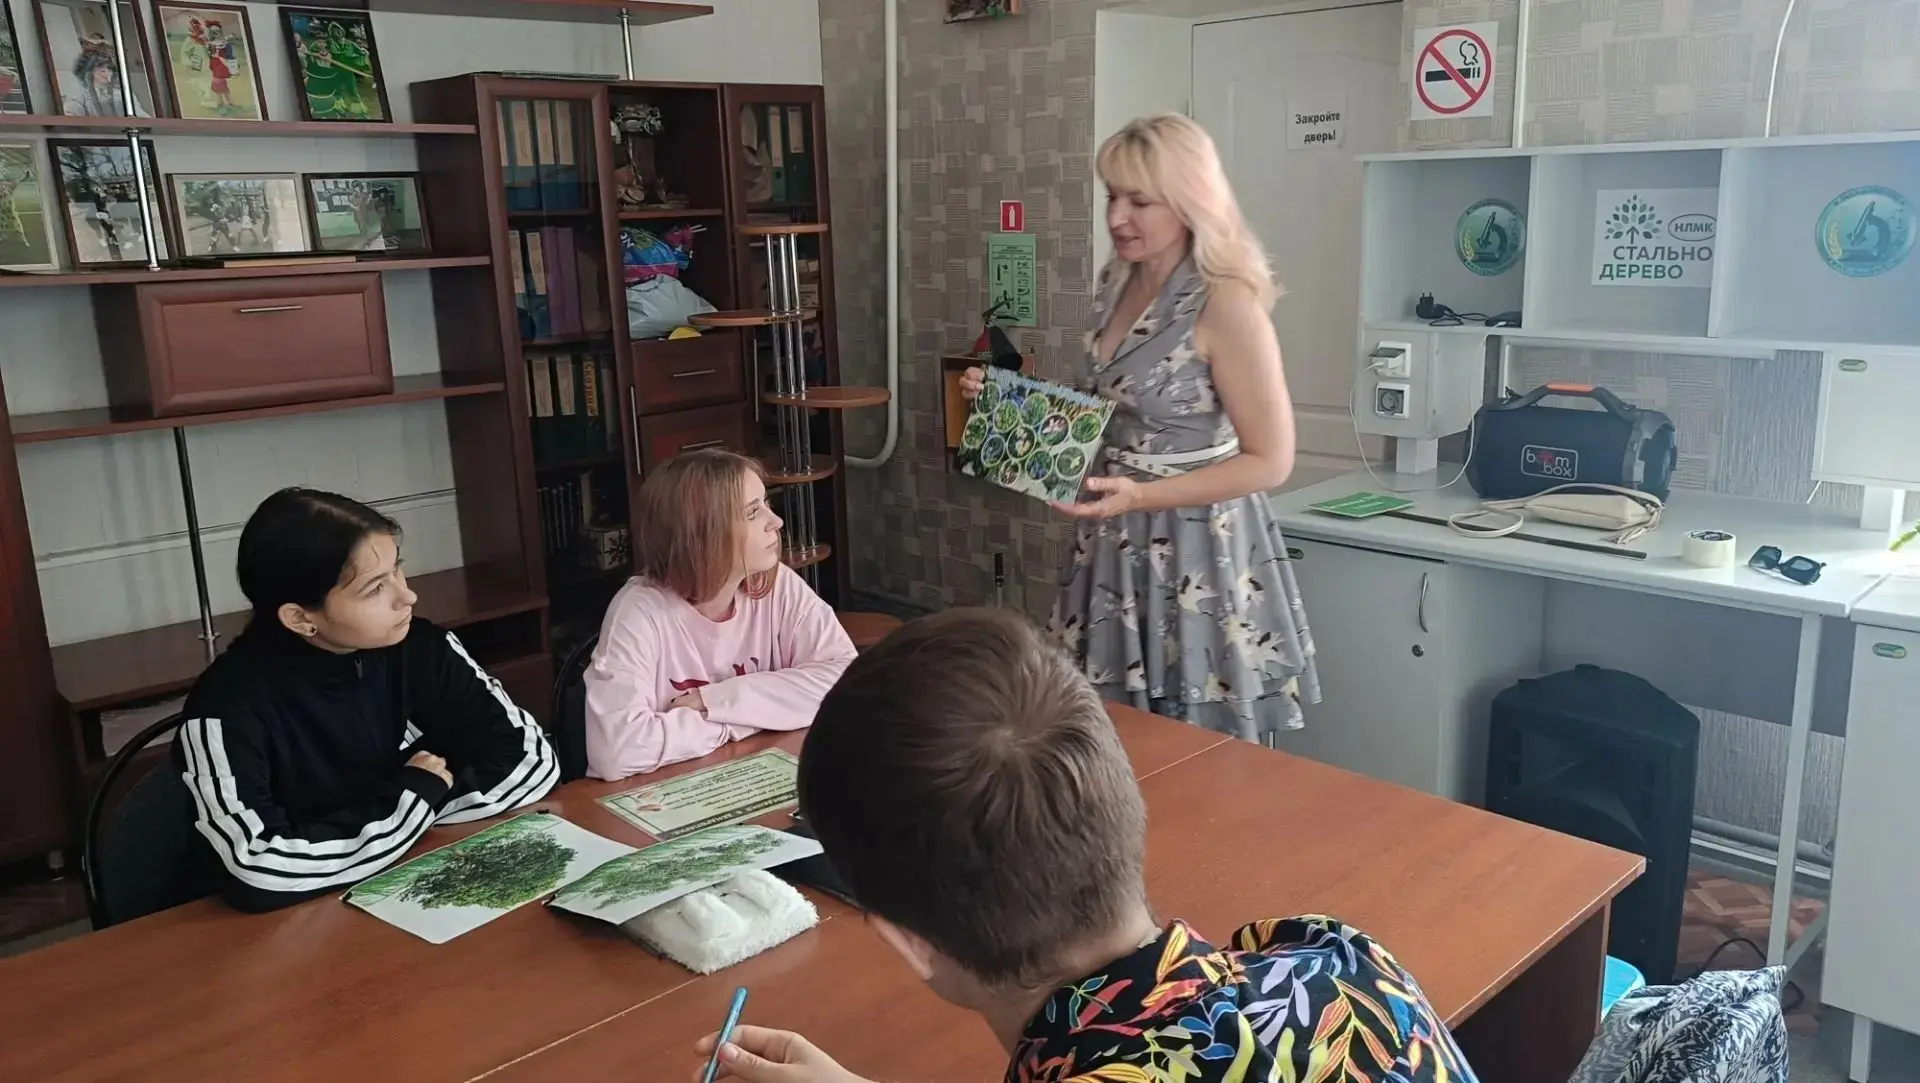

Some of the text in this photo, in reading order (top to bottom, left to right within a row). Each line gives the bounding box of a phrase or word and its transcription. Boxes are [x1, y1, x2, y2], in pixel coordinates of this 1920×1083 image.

[1295, 111, 1340, 125] Закройте
[1304, 129, 1335, 144] дверь!
[1674, 222, 1713, 233] НЛМК
[1613, 245, 1713, 261] СТАЛЬНО
[1599, 263, 1684, 281] ДЕРЕВО
[1526, 449, 1570, 468] bm
[1543, 461, 1572, 477] box
